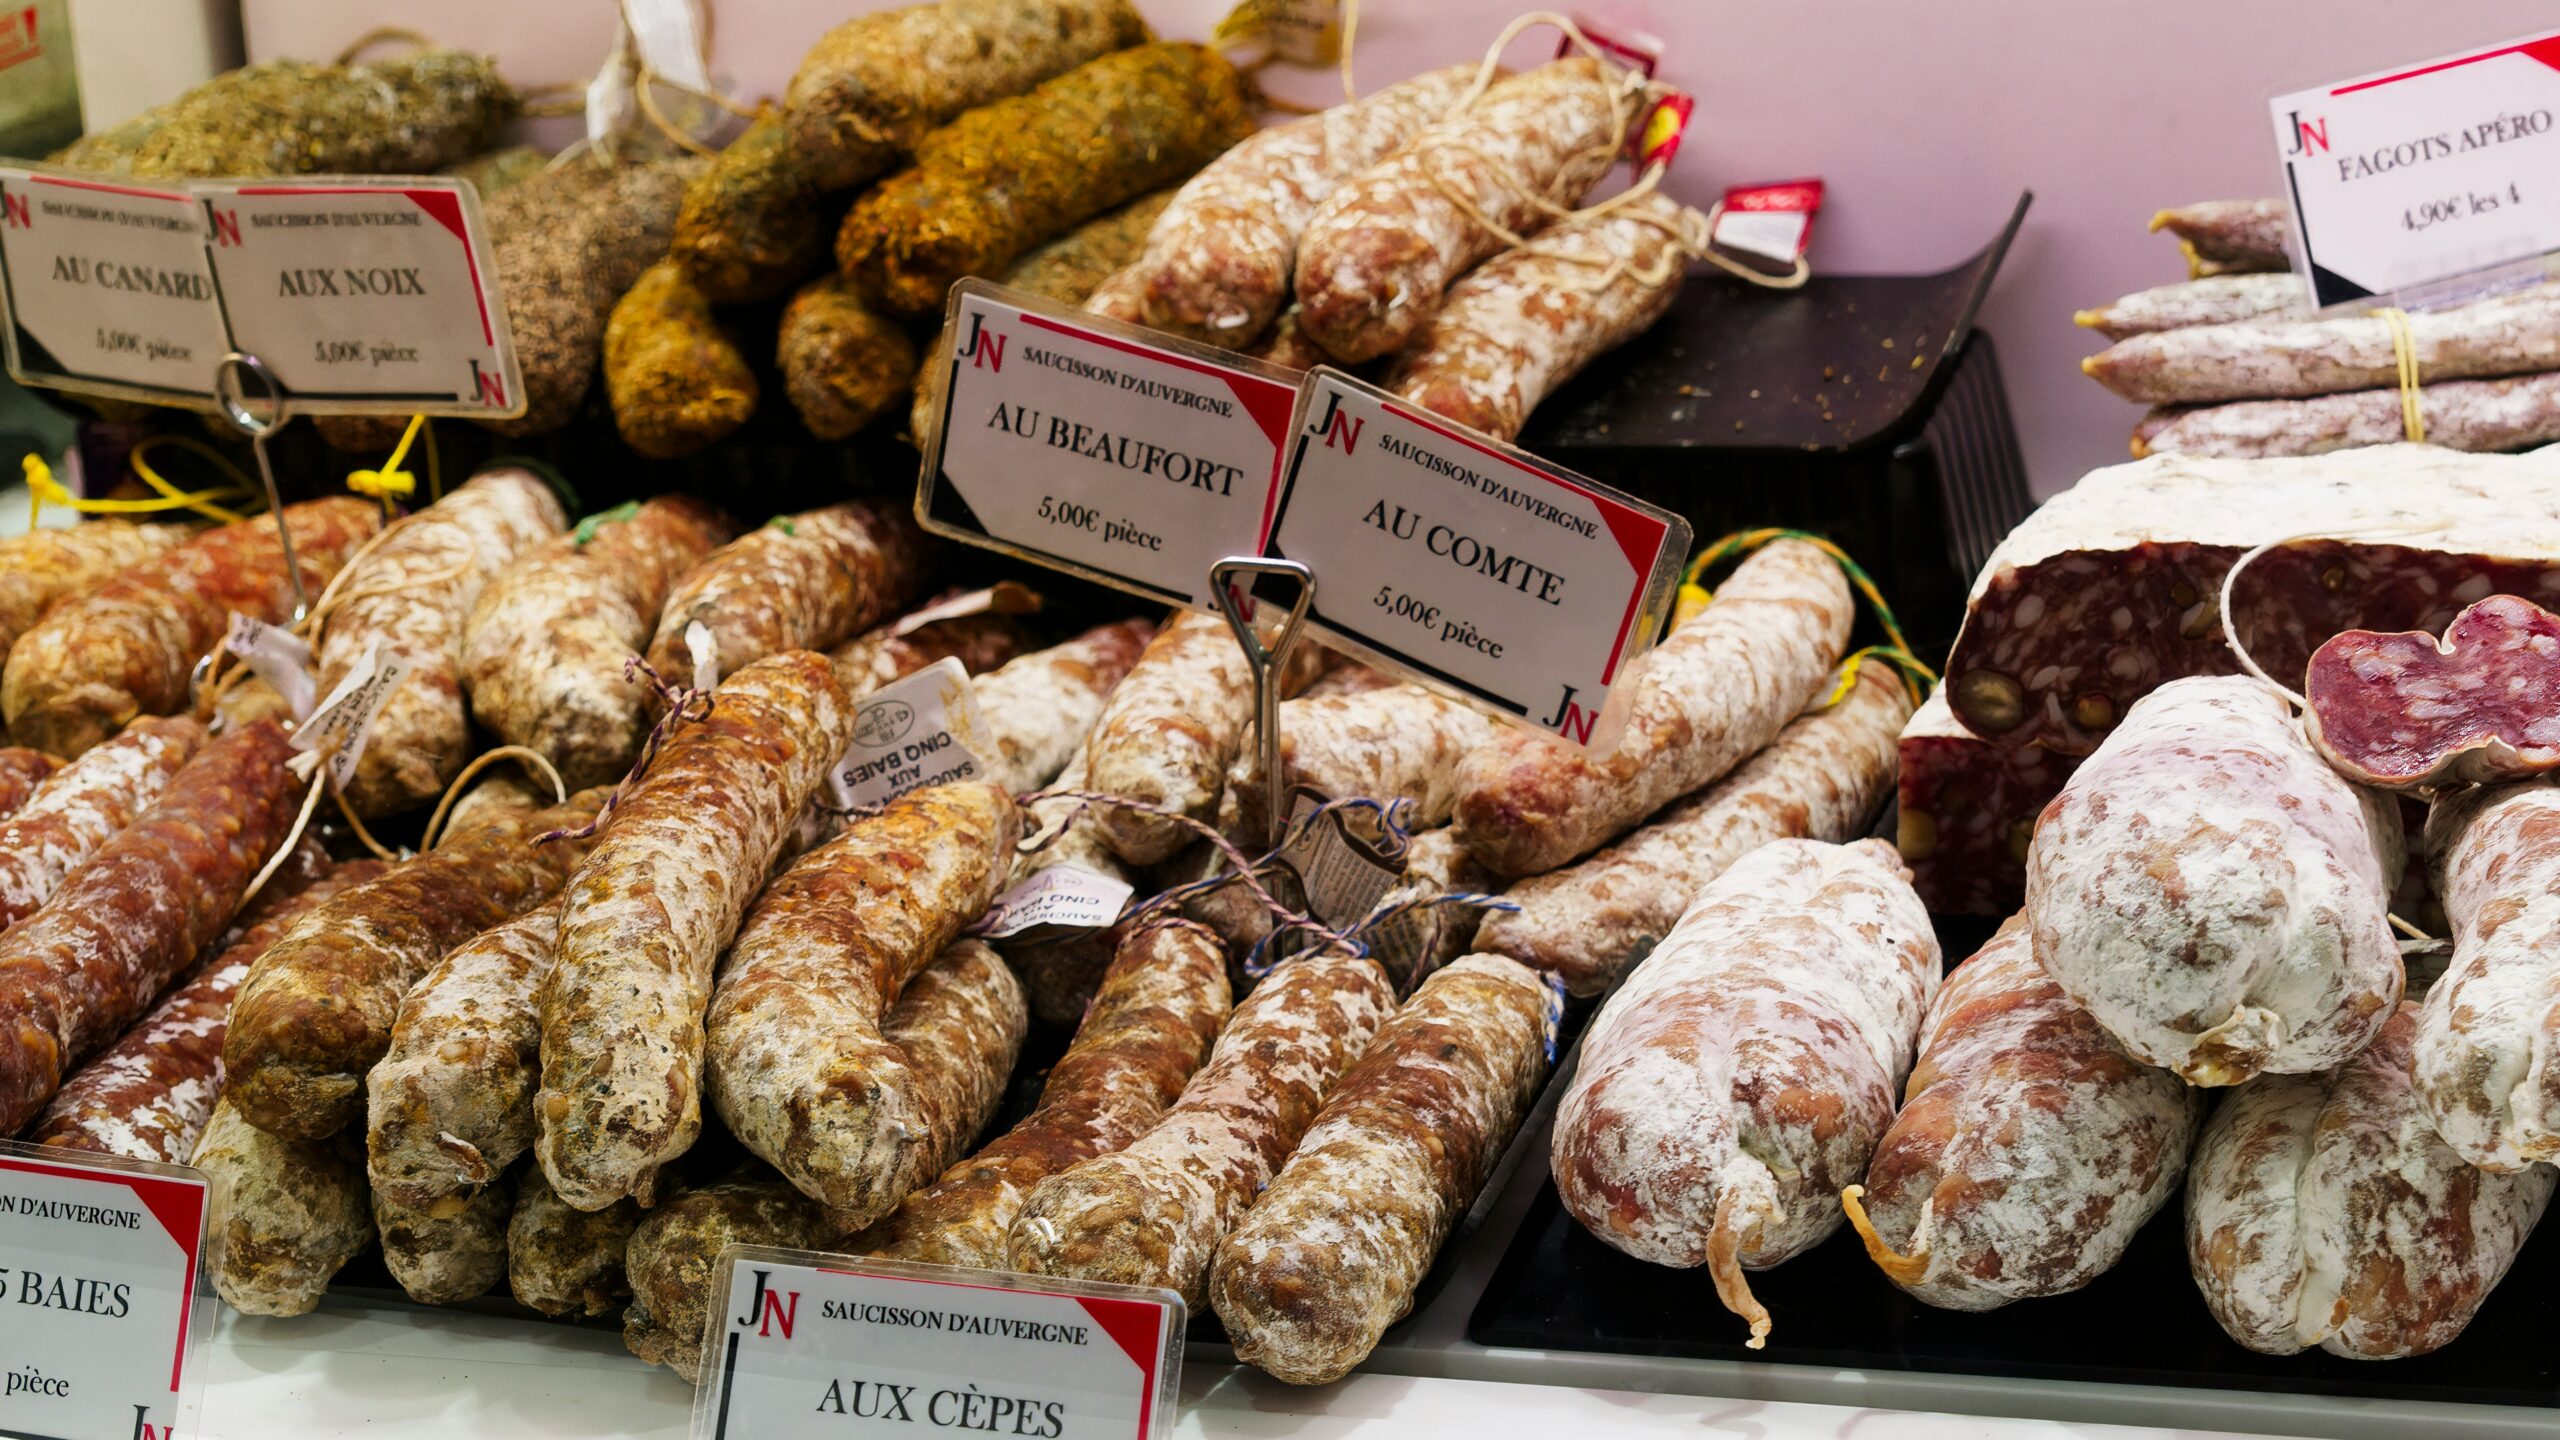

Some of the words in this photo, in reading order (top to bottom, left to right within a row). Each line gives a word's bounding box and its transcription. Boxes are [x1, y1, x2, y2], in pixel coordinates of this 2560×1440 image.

[2287, 111, 2330, 157] JN
[2338, 132, 2452, 182] FAGOTS
[2459, 108, 2554, 153] APÉRO
[205, 199, 243, 247] JN
[2401, 194, 2465, 232] 4,90€
[2468, 190, 2500, 215] les
[2507, 181, 2521, 205] 4
[53, 255, 89, 284] AU
[95, 261, 212, 301] CANARD
[279, 270, 340, 297] AUX
[344, 267, 426, 296] NOIX
[958, 313, 1007, 373] JN
[469, 359, 507, 408] JN
[1023, 346, 1118, 386] SAUCISSON
[1120, 374, 1233, 418] D'AUVERGNE
[1309, 391, 1364, 456] JN
[988, 402, 1040, 438] AU
[1047, 416, 1244, 497] BEAUFORT
[1378, 433, 1480, 489] SAUCISSON
[1481, 477, 1599, 540] D'AUVERGNE
[1038, 496, 1101, 532] 5,00€
[1103, 518, 1162, 551] pièce
[1362, 499, 1421, 540] AU
[1426, 524, 1565, 607] COMTE
[1373, 585, 1440, 630] 5,00€
[1440, 620, 1504, 660] pièce
[1542, 684, 1599, 746] JN
[842, 752, 902, 788] BAIES
[904, 731, 952, 761] CINQ
[887, 764, 921, 789] AUX
[19, 1197, 141, 1230] D'AUVERGNE
[17, 1270, 131, 1318] BAIES
[737, 1270, 800, 1340] JN
[821, 1300, 943, 1330] SAUCISSON
[948, 1314, 1089, 1346] D'AUVERGNE
[5, 1365, 70, 1398] pièce
[816, 1378, 914, 1423] AUX
[928, 1383, 1065, 1440] CÈPES
